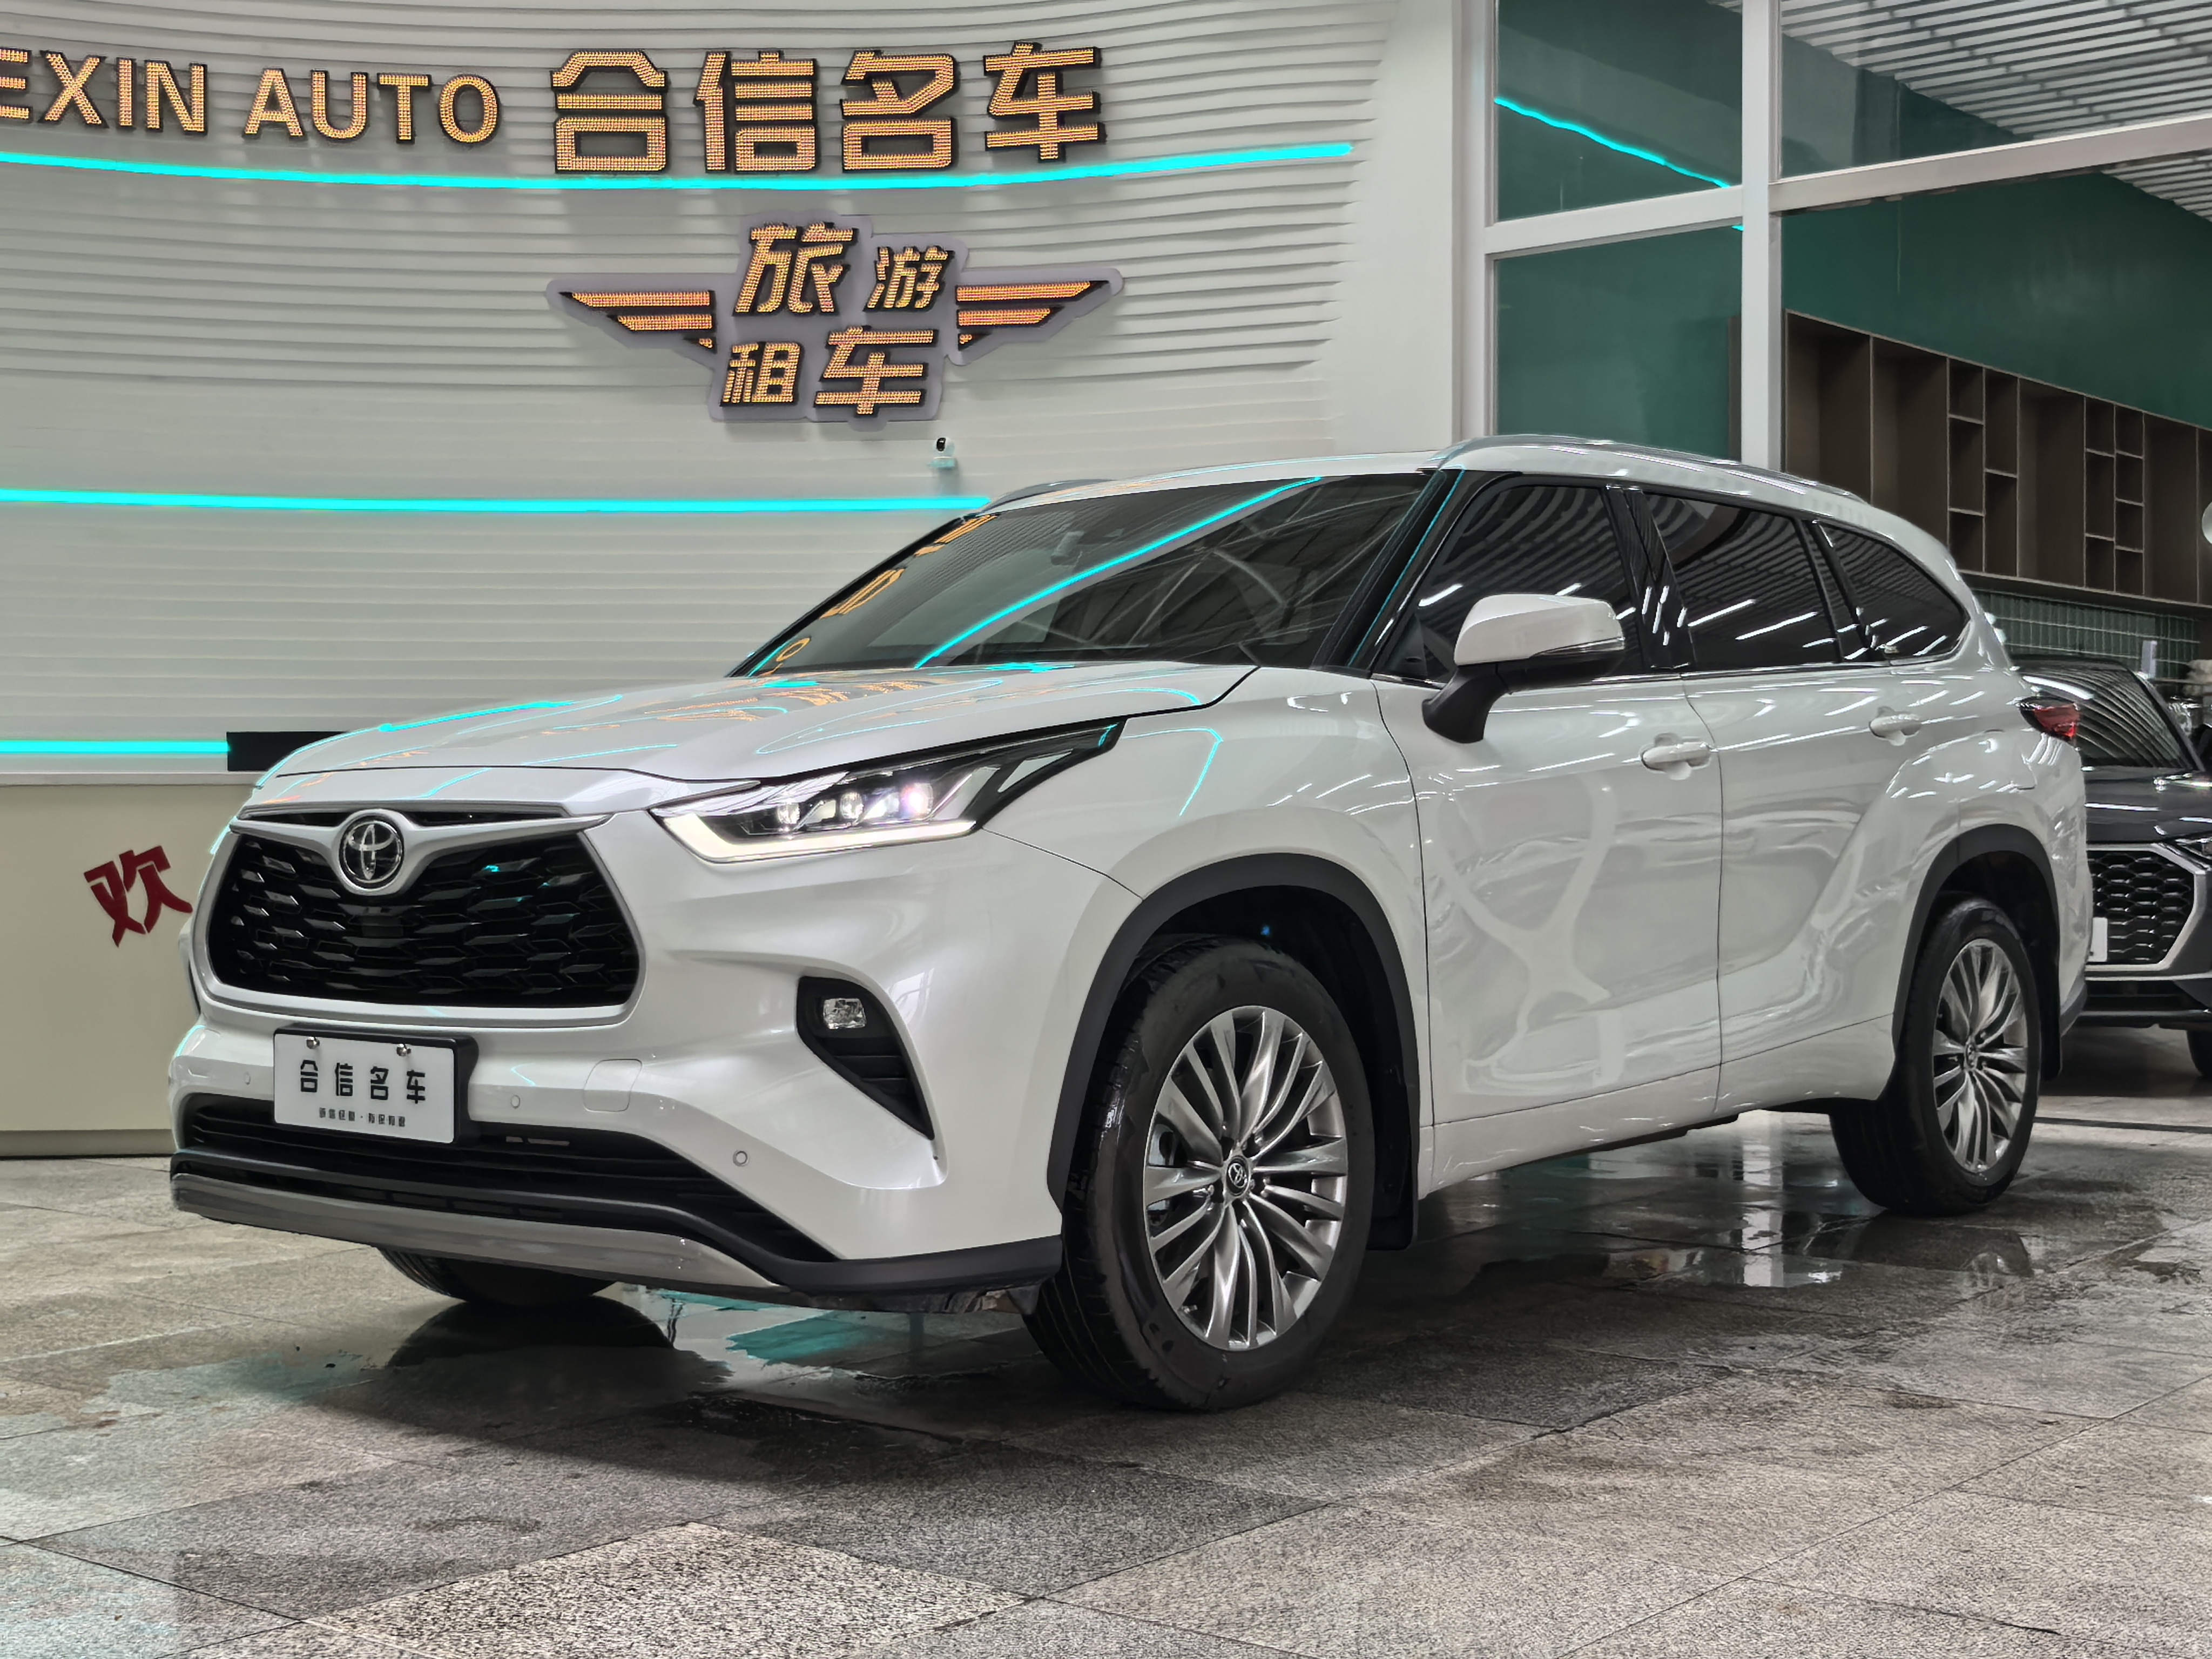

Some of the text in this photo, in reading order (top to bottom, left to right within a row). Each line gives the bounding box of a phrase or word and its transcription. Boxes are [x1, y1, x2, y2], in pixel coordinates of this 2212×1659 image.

[242, 67, 502, 148] AUTO
[550, 41, 1107, 174] 合信名车
[732, 221, 954, 316] 旅游
[720, 325, 940, 417] 租车
[84, 845, 193, 948] 欢
[300, 1059, 426, 1104] 合信名车
